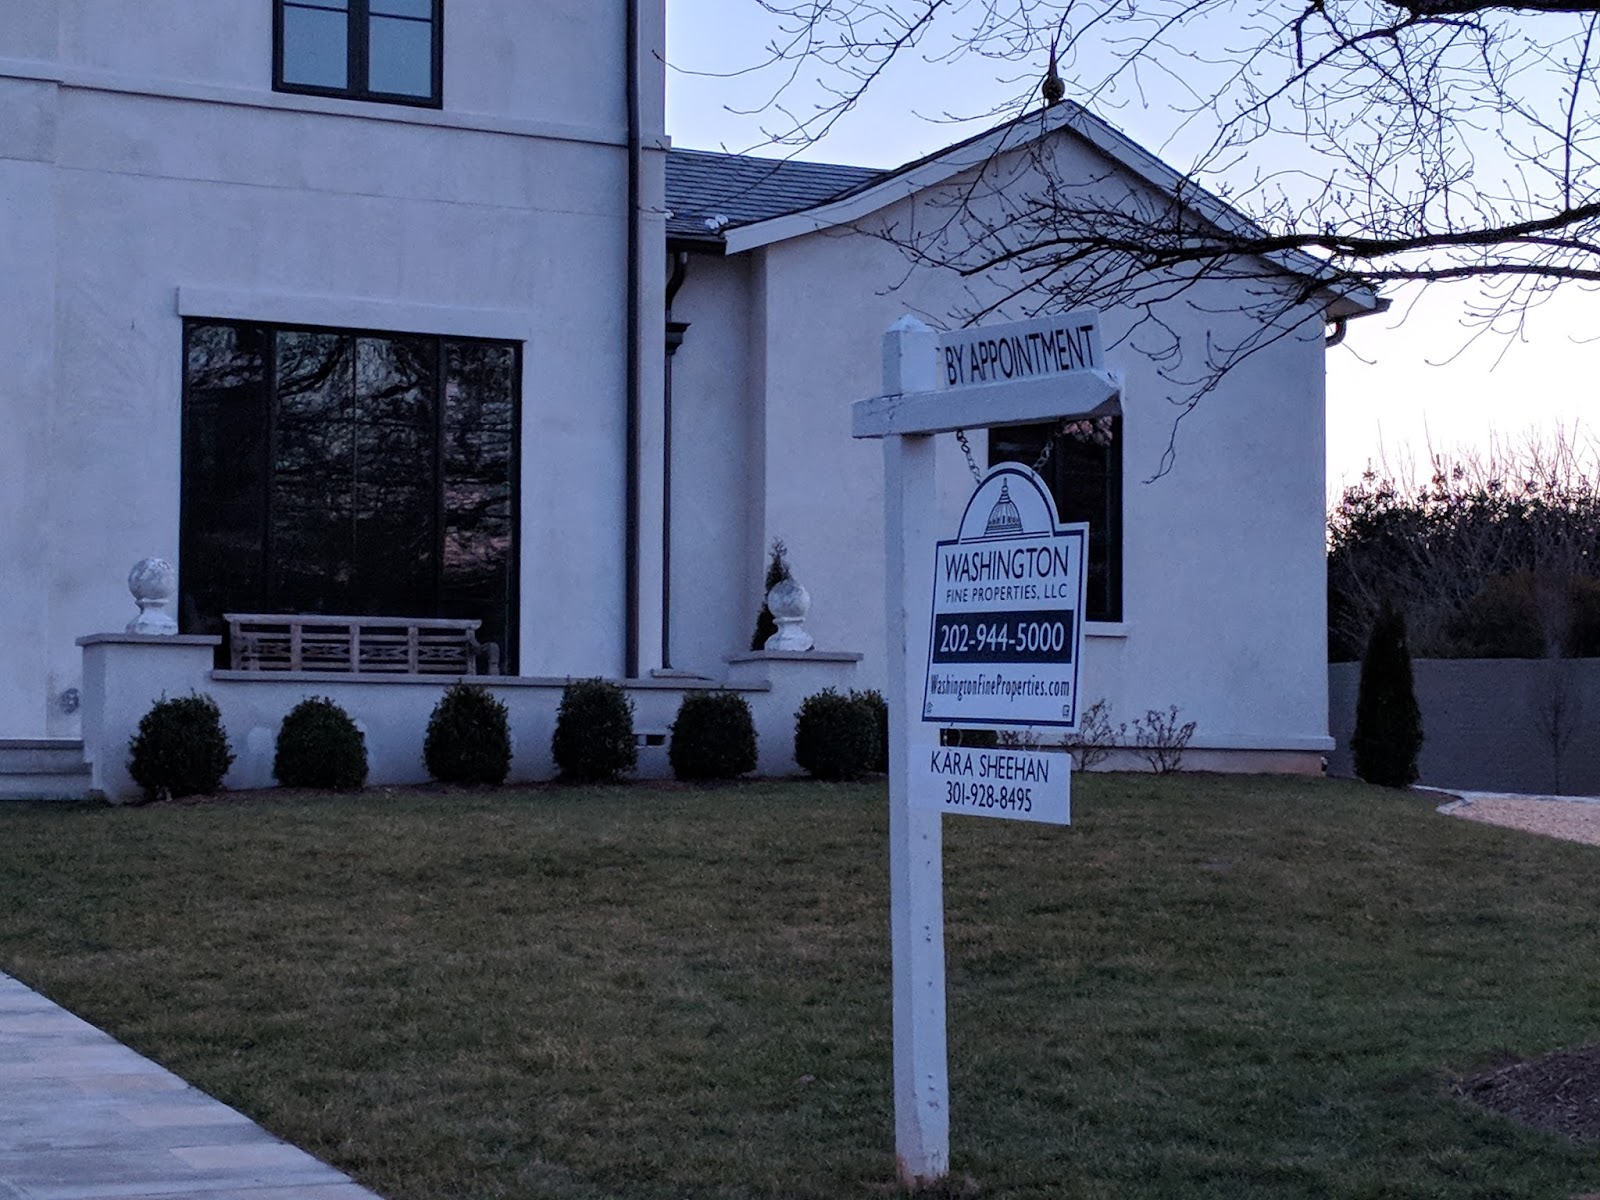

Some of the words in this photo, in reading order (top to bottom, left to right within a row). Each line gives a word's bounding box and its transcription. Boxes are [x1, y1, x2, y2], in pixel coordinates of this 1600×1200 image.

[945, 344, 964, 385] BY
[971, 325, 1093, 383] APPOINTMENT
[945, 545, 1069, 582] WASHINGTON
[946, 587, 968, 603] FINE
[1044, 583, 1067, 598] LLC
[940, 622, 1065, 652] 202-944-5000
[930, 673, 1070, 702] WashingtonFineProperties.com
[931, 751, 973, 776] KARA
[979, 754, 1049, 783] SHEEHAN
[945, 781, 1032, 812] 301-928-8495
